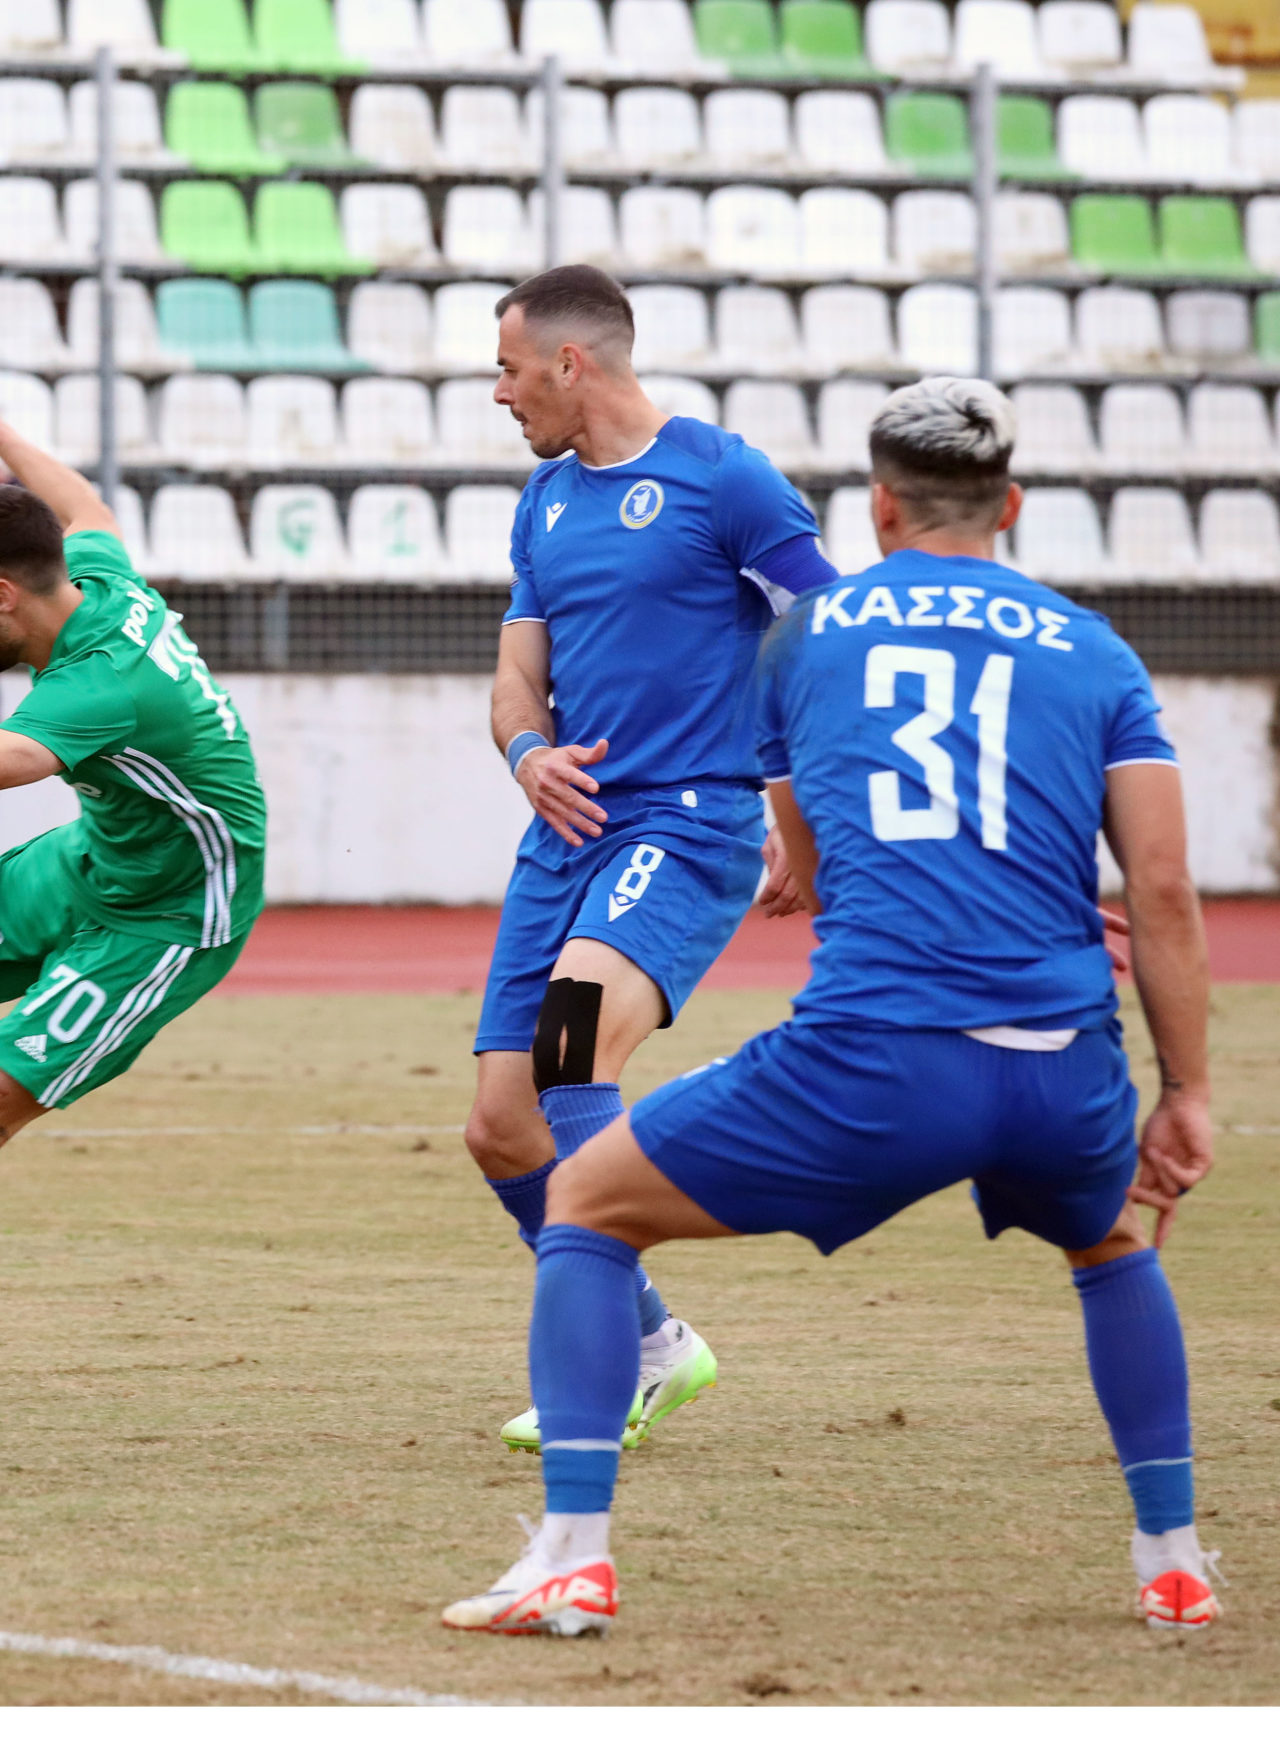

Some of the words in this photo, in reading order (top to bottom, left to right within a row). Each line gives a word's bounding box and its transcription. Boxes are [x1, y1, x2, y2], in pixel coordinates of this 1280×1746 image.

[811, 585, 1074, 652] ΚΑΣΣΟΣ
[863, 644, 1015, 851] 31
[614, 843, 666, 900] 8
[22, 964, 108, 1044] 70
